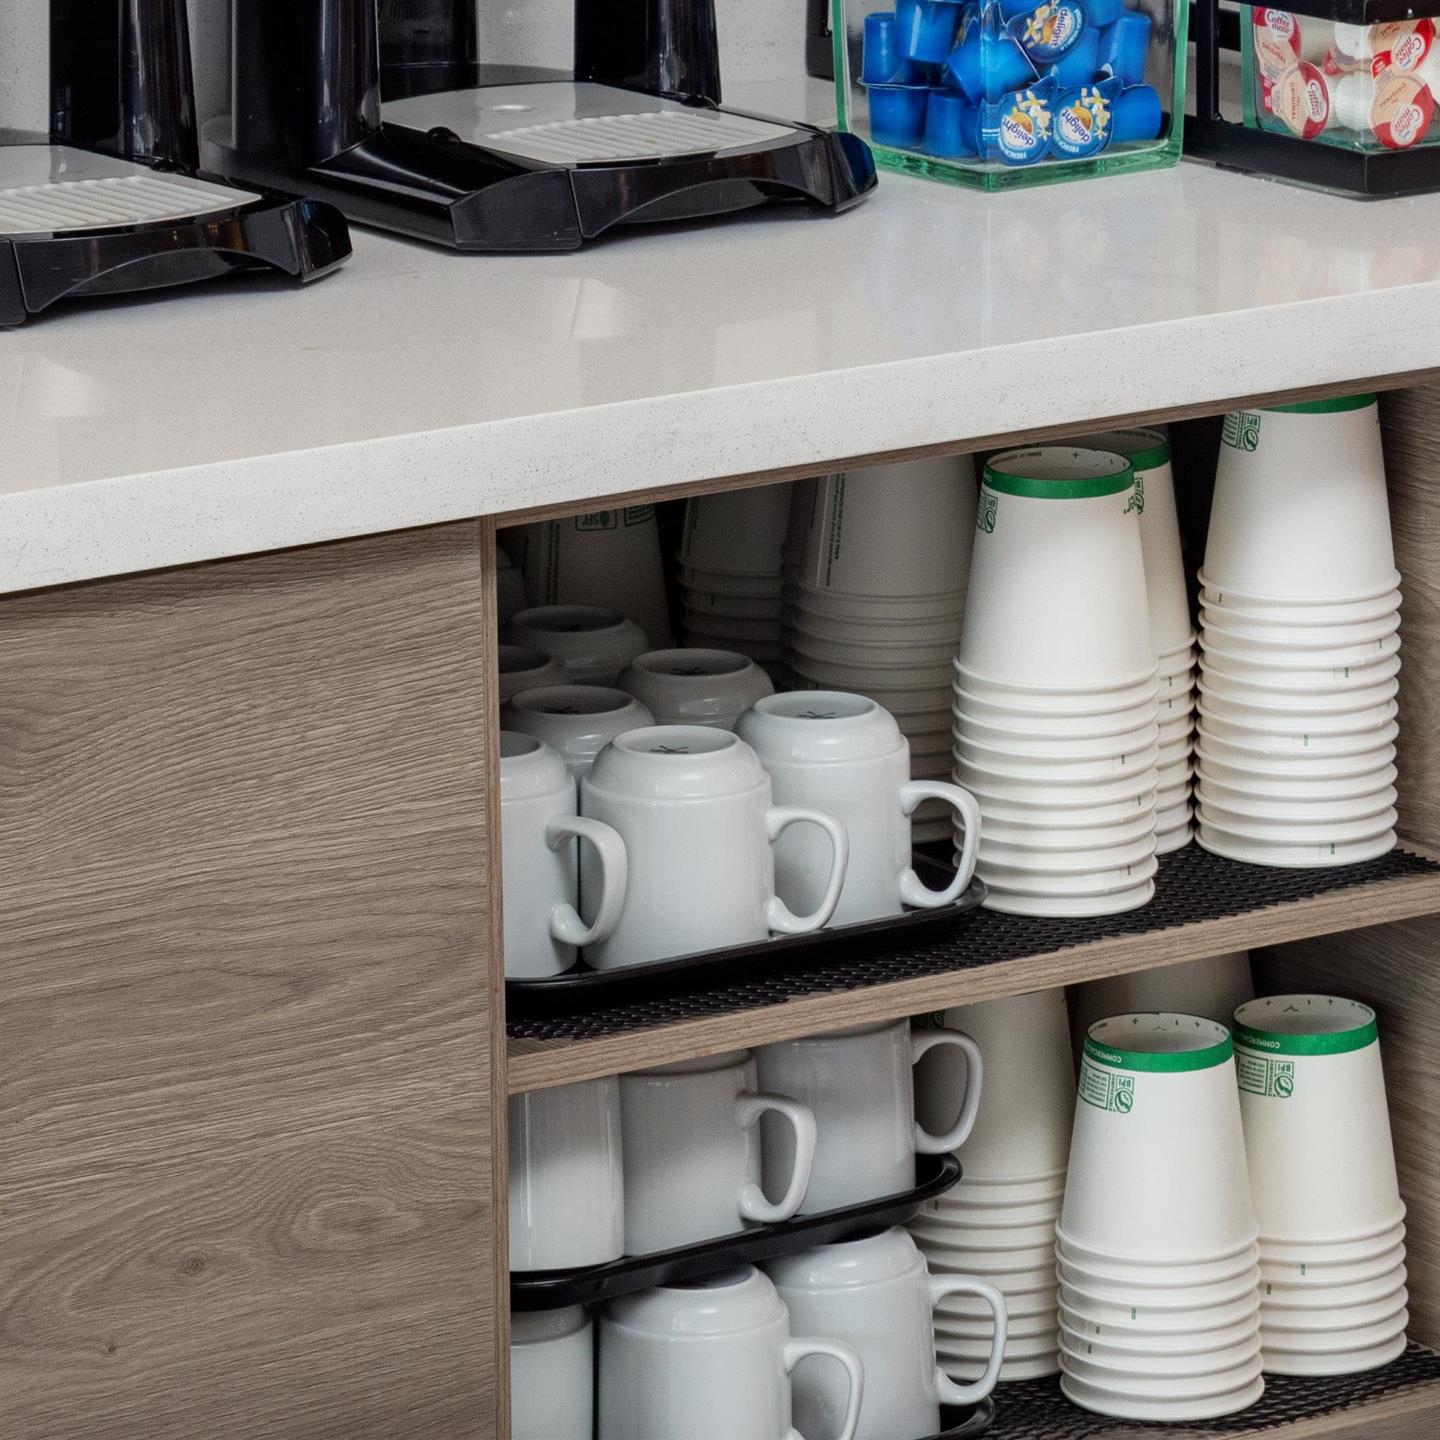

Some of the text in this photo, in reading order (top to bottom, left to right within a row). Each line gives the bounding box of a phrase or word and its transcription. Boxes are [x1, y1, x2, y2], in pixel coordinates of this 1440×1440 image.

[1050, 8, 1069, 47] delight
[1266, 10, 1290, 28] Coffee
[1394, 35, 1412, 61] mate
[1399, 37, 1422, 65] Coffee
[1290, 81, 1298, 120] ORIGINAL
[1380, 82, 1408, 109] ORIGINAL
[1002, 118, 1035, 146] delight
[1062, 109, 1090, 143] delight
[1394, 106, 1411, 133] mate
[1398, 108, 1421, 135] Coffee
[1277, 1064, 1291, 1072] BPI
[1118, 1077, 1132, 1088] BPI
